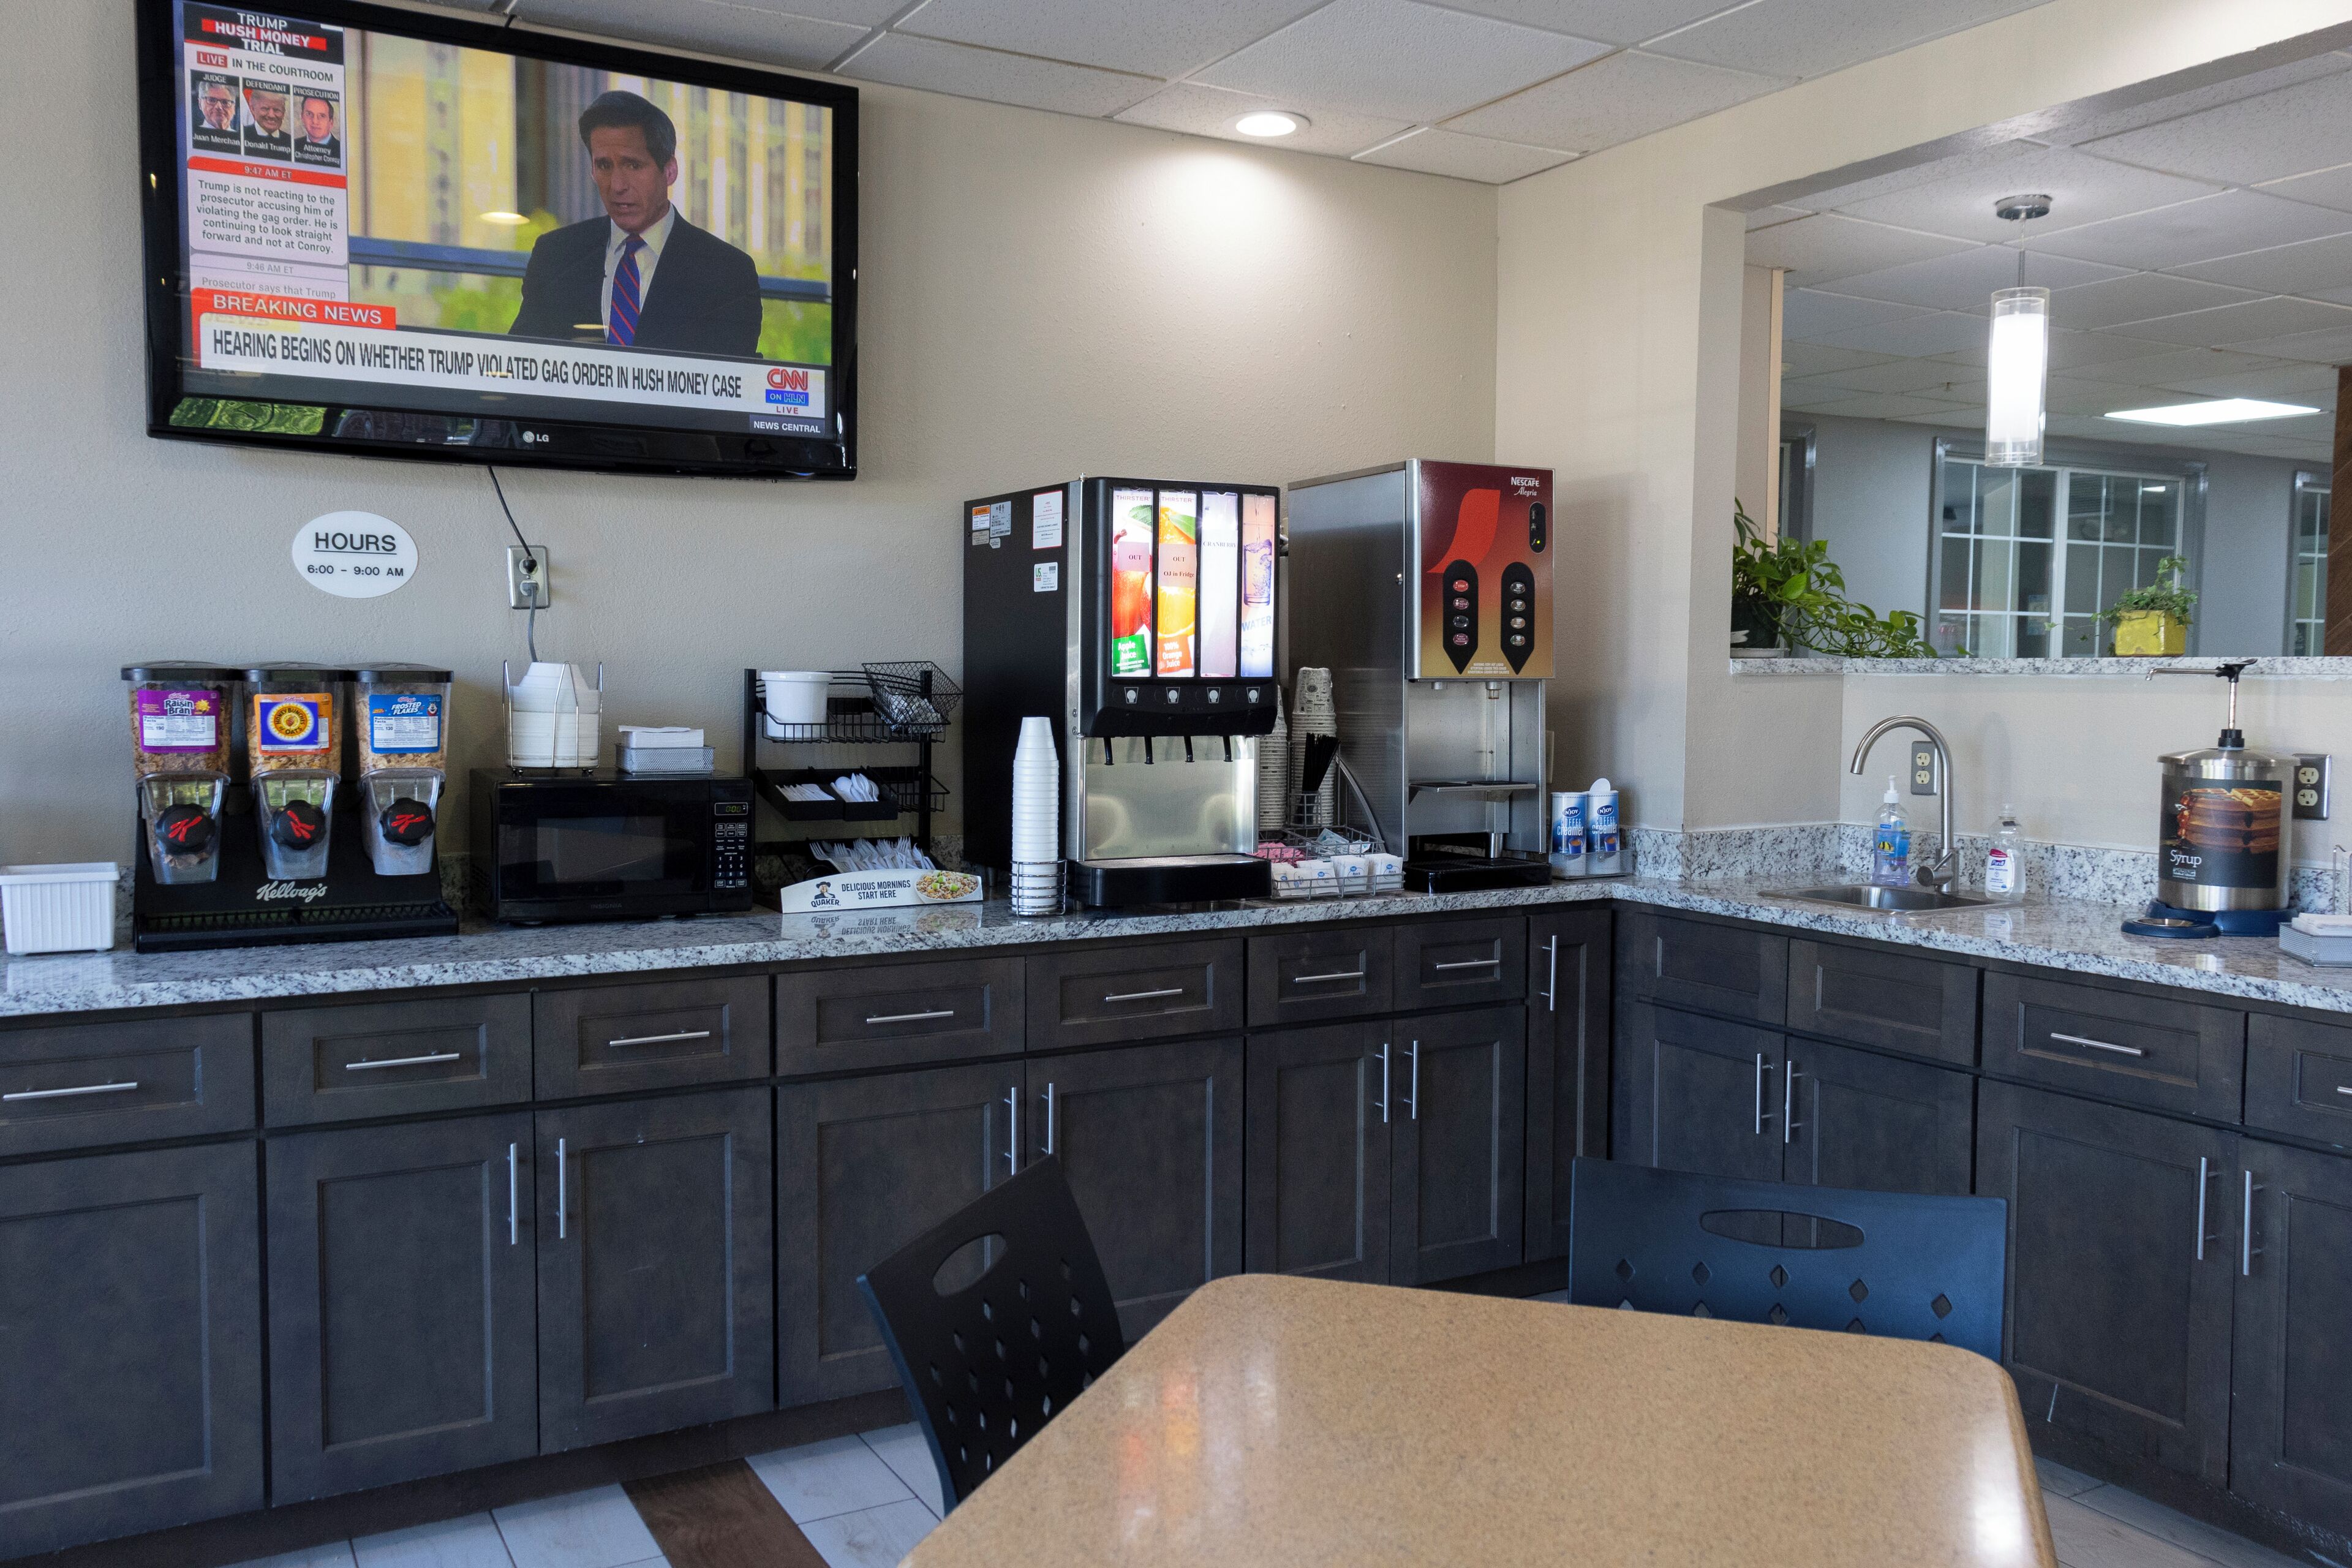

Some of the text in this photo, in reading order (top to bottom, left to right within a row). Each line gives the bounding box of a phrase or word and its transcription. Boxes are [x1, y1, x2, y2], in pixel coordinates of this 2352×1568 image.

[237, 12, 287, 30] TRUMP
[215, 21, 310, 47] HUSH MONEY
[241, 39, 284, 55] TRIAL
[198, 53, 333, 82] LIVE IN THE COURTROOM
[203, 74, 226, 83] JUDGE
[246, 80, 286, 92] DEFENDANT
[293, 86, 339, 100] PROSECUTION
[192, 133, 240, 146] Juan Merchan
[244, 140, 291, 154] Donald Trump
[304, 145, 331, 155] Attorney
[244, 165, 292, 178] 9:47 AM ET
[198, 179, 335, 205] Trump is not reacting to the
[200, 192, 334, 217] prosecutor accusing him of
[197, 205, 239, 219] violating
[243, 210, 258, 220] the
[262, 214, 280, 225] gag
[283, 216, 311, 227] order.
[330, 221, 338, 230] is
[203, 218, 333, 241] continuing to look straight
[202, 230, 241, 243] forward
[244, 235, 262, 245] and
[266, 237, 282, 247] not
[298, 241, 334, 254] Conroy.
[267, 265, 281, 273] AM
[202, 277, 336, 300] Prosecutor says that Trump
[214, 294, 382, 325] BREAKING NEWS
[213, 329, 741, 398] HEARING BEGINS ON WHETHER TRUMP VIOLATED GAG ORDER IN HUSH MONEY CASE
[767, 368, 809, 391] CNN
[770, 393, 805, 404] ON HLN
[776, 405, 799, 415] LIVE
[754, 421, 821, 433] NEWS CENTRAL
[1514, 487, 1537, 497] Alegria
[315, 532, 396, 552] HOURS
[307, 565, 334, 575] 6:00
[354, 567, 380, 576] 9:00
[386, 568, 404, 576] AM
[1242, 616, 1272, 632] WATER
[1118, 641, 1136, 651] Apple
[1164, 641, 1179, 650] 100%
[1120, 650, 1136, 659] Juice
[1163, 650, 1182, 659] Orange
[1166, 660, 1180, 668] Juice
[165, 700, 193, 709] Raisin
[276, 708, 287, 725] HONEY
[288, 707, 305, 725] BUNCHES
[285, 726, 303, 735] OATS
[1557, 826, 1584, 836] creamer
[1592, 824, 1617, 834] creamer
[2170, 850, 2202, 868] Syrup
[256, 881, 328, 903] Kellogg's
[842, 880, 911, 892] DELICIOUS MORNINGS
[858, 890, 897, 900] START HERE
[811, 899, 840, 907] QUAKER
